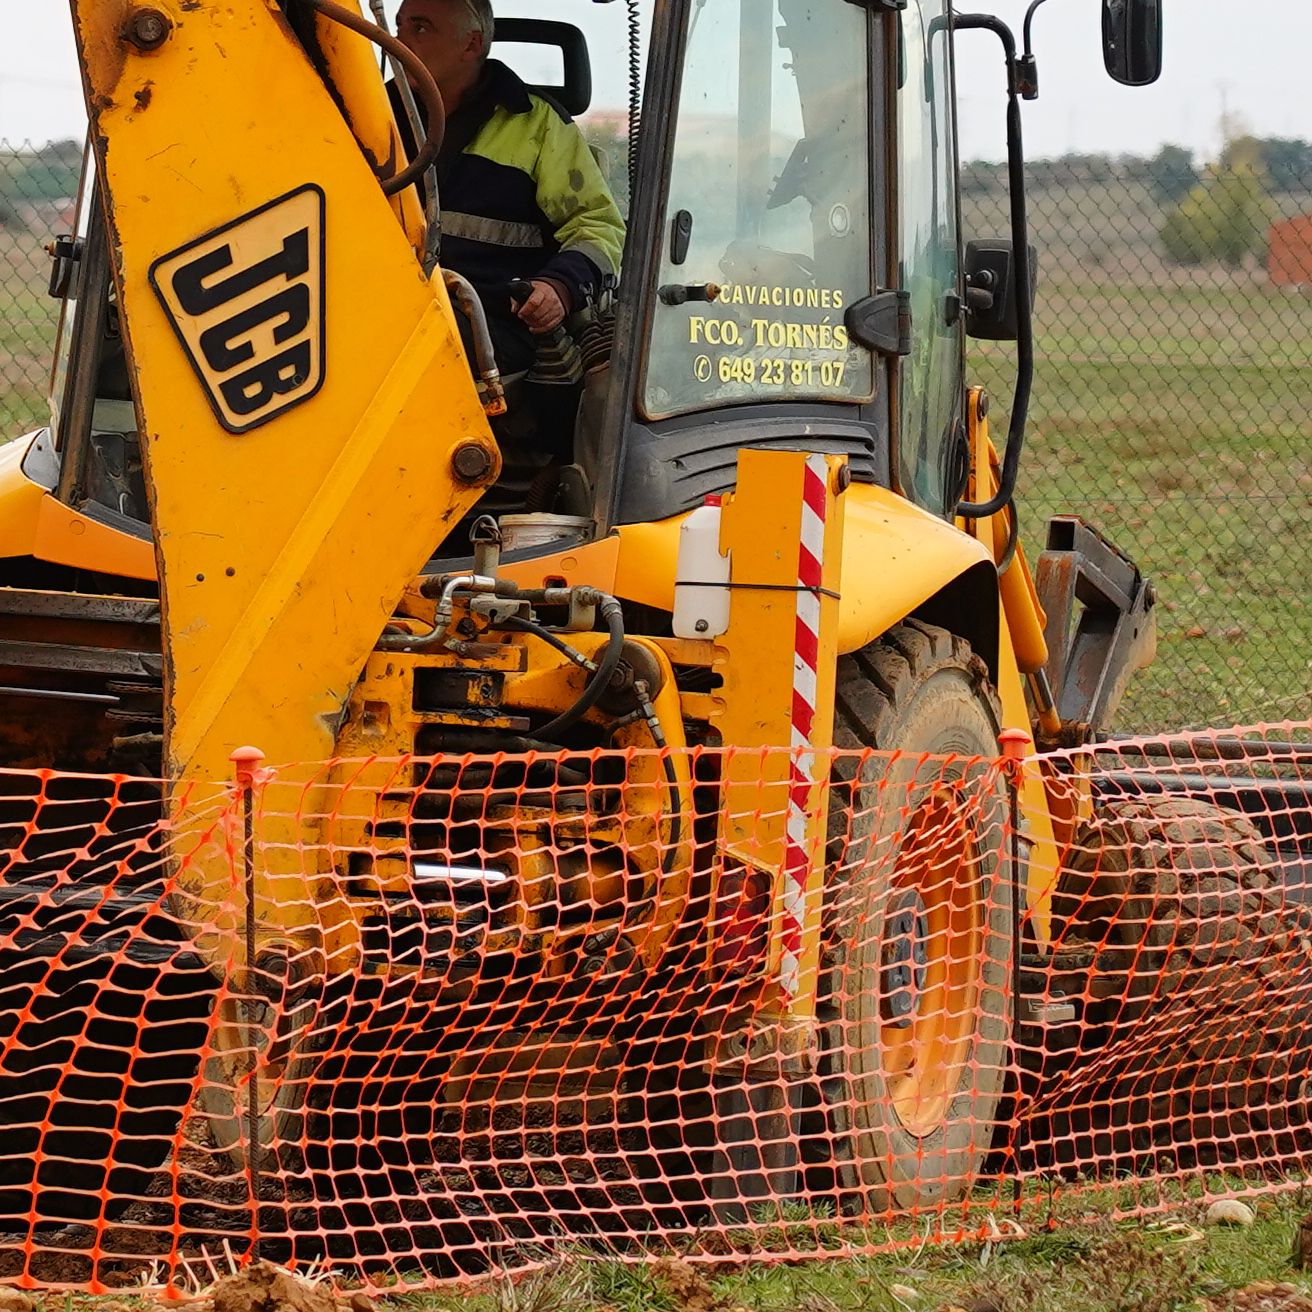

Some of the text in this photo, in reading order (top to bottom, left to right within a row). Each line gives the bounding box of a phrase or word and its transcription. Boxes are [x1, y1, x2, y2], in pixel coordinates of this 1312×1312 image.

[718, 284, 843, 308] CAVACIONES
[172, 227, 310, 415] JCB
[720, 357, 844, 387] 649 23 81 07
